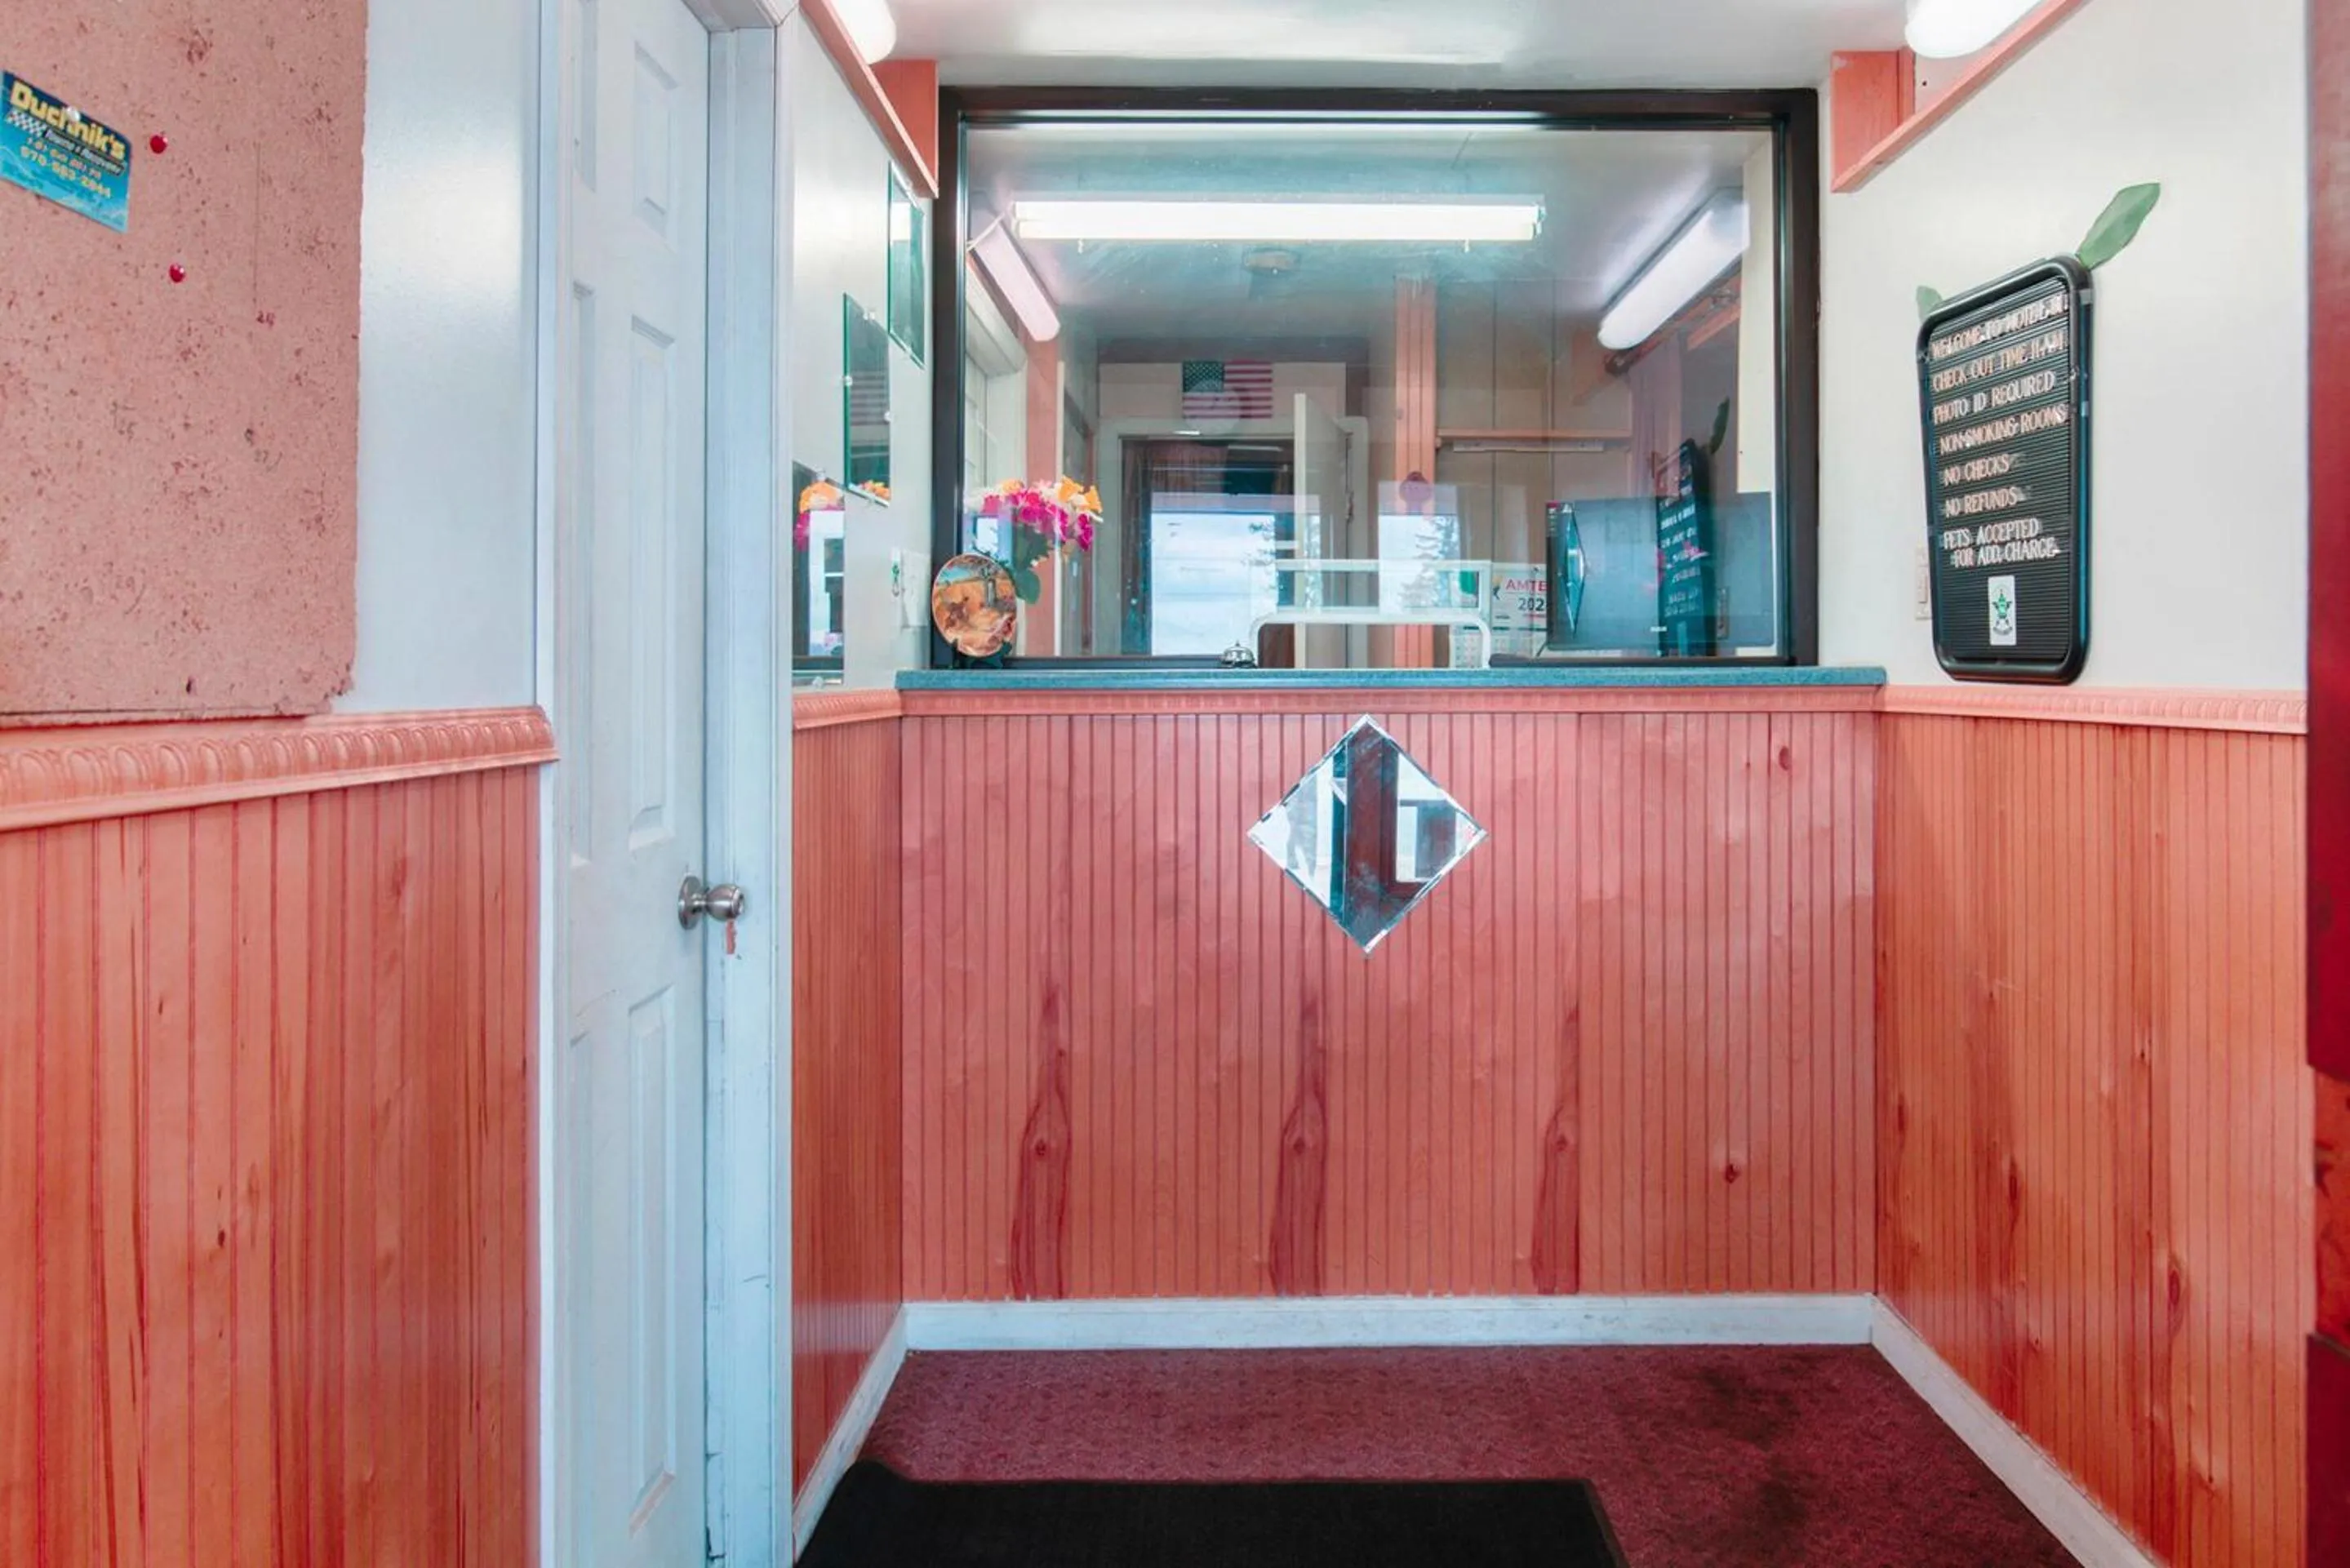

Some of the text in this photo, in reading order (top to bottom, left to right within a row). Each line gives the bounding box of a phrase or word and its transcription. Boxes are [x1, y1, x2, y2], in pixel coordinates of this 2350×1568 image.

[1930, 328, 1982, 359] WELCOME
[1933, 366, 1967, 392] CHECK
[1971, 358, 1995, 380] OUT
[1999, 346, 2028, 370] TIME
[1933, 370, 2055, 425] PHOTO ID REQUIRED
[2019, 403, 2068, 433] ROOMS
[1944, 454, 2010, 486] NO CHECKS
[1945, 486, 2018, 517] NO REFUNDS
[1944, 517, 2039, 550] PETS ACCEPTED
[1953, 547, 1973, 568] FOR
